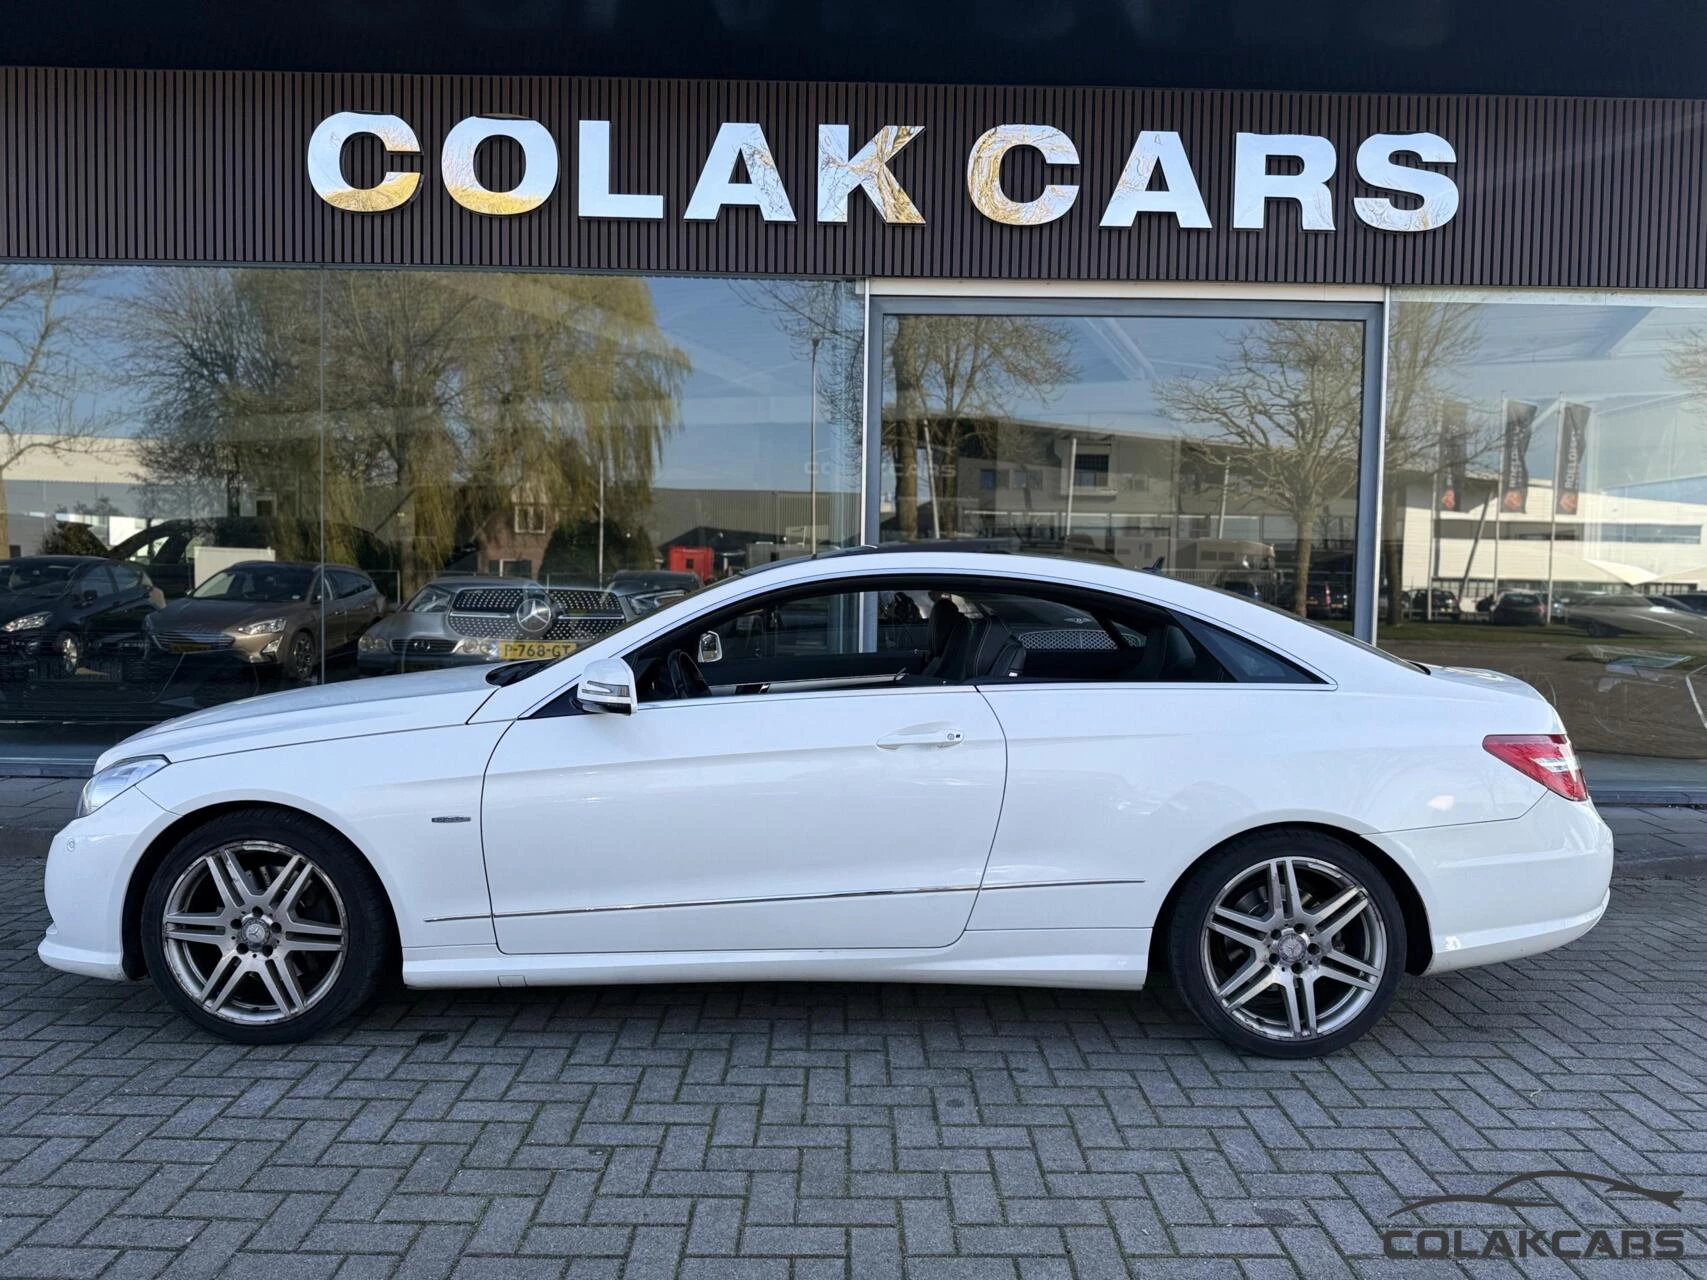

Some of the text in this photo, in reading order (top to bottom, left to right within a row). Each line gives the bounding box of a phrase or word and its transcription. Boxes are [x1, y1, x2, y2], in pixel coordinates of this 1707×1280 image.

[307, 110, 1460, 233] COLAK CARS
[504, 644, 571, 657] P-768-GT
